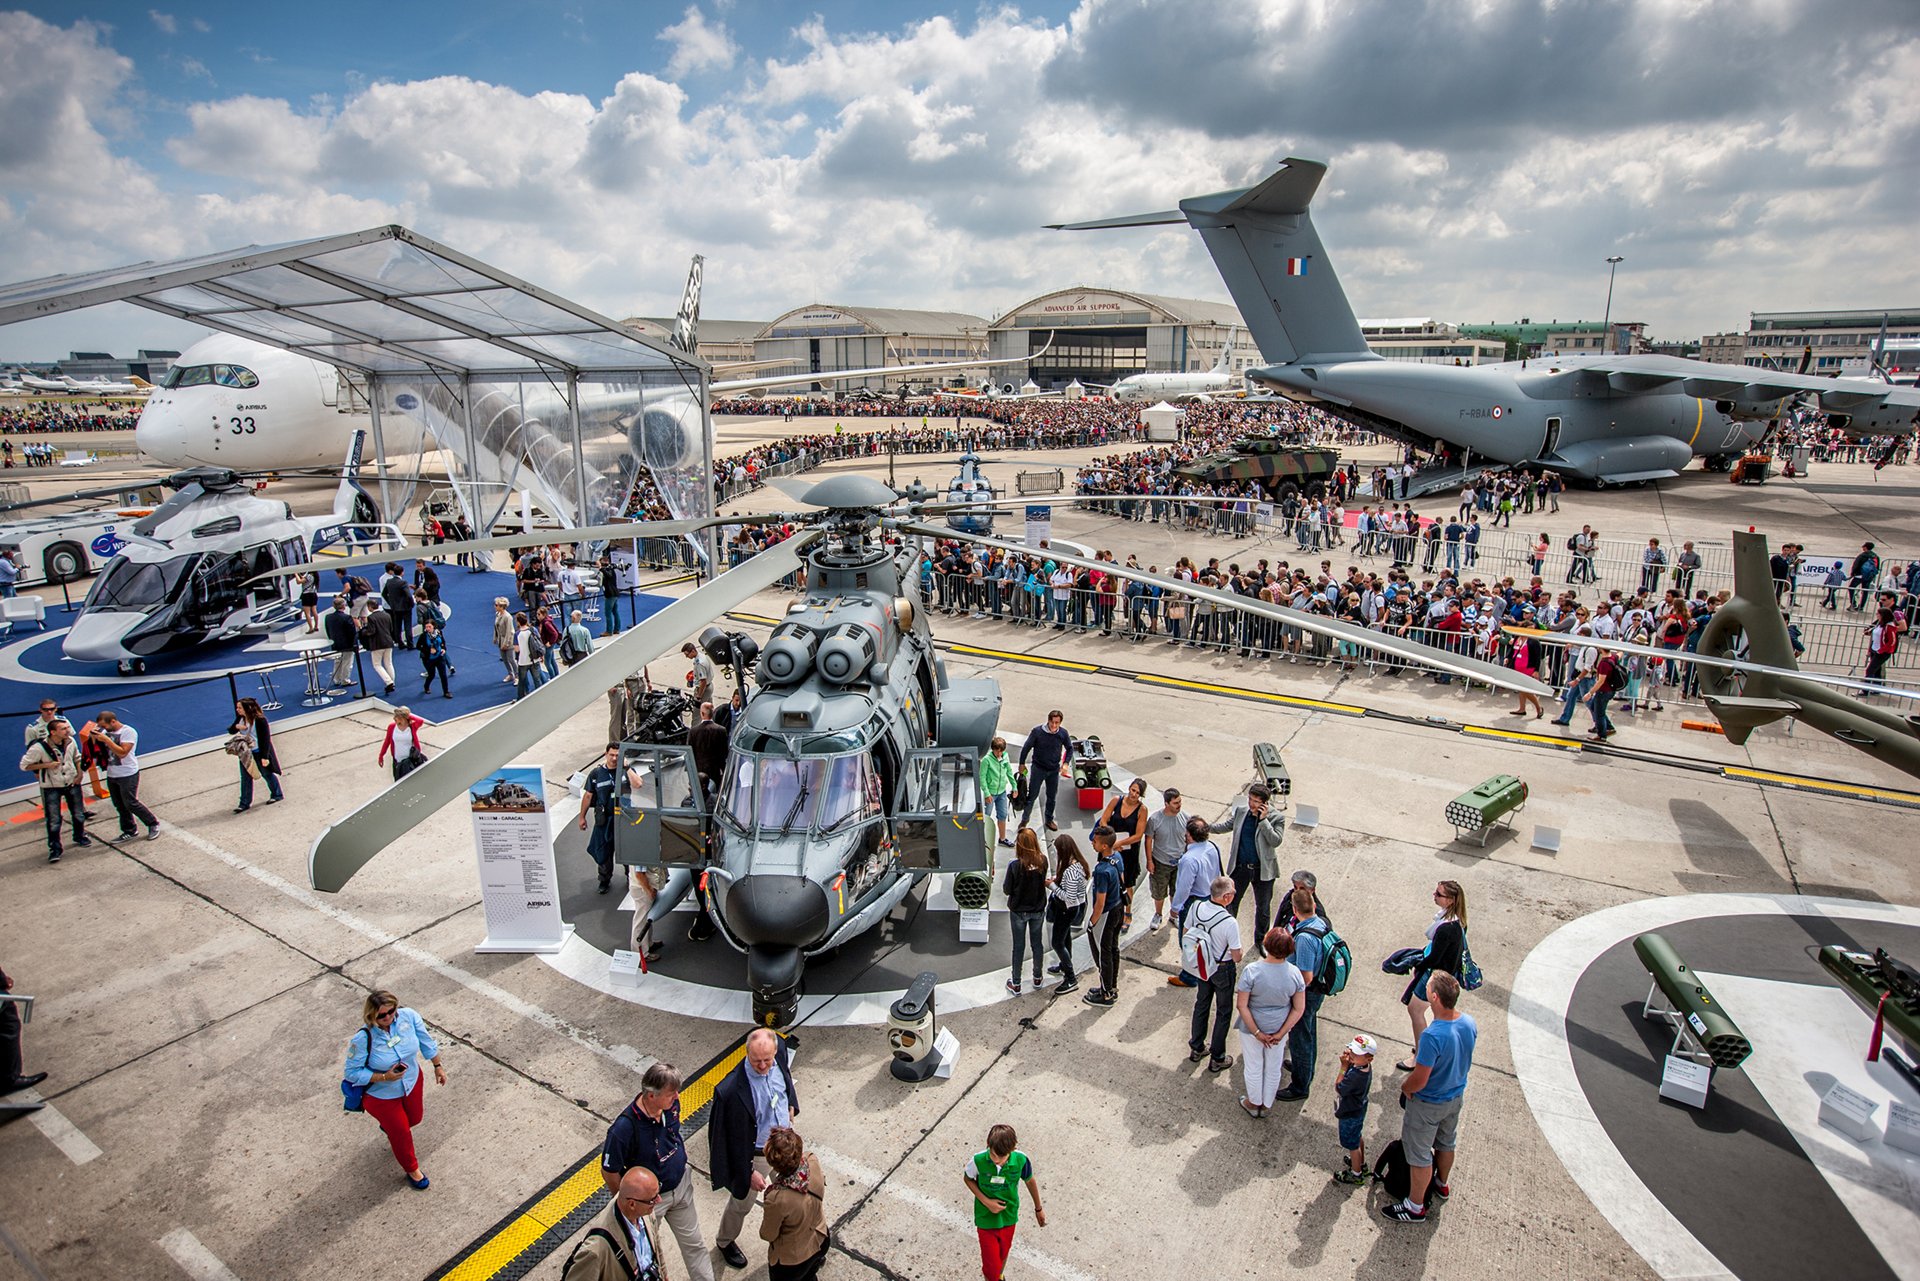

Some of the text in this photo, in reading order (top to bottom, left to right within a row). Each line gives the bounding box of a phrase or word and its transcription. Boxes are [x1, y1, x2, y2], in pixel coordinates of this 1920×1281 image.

[1459, 408, 1491, 419] F-RBAA
[230, 416, 256, 435] 33
[1802, 565, 1835, 574] AIRBU
[562, 574, 571, 584] H
